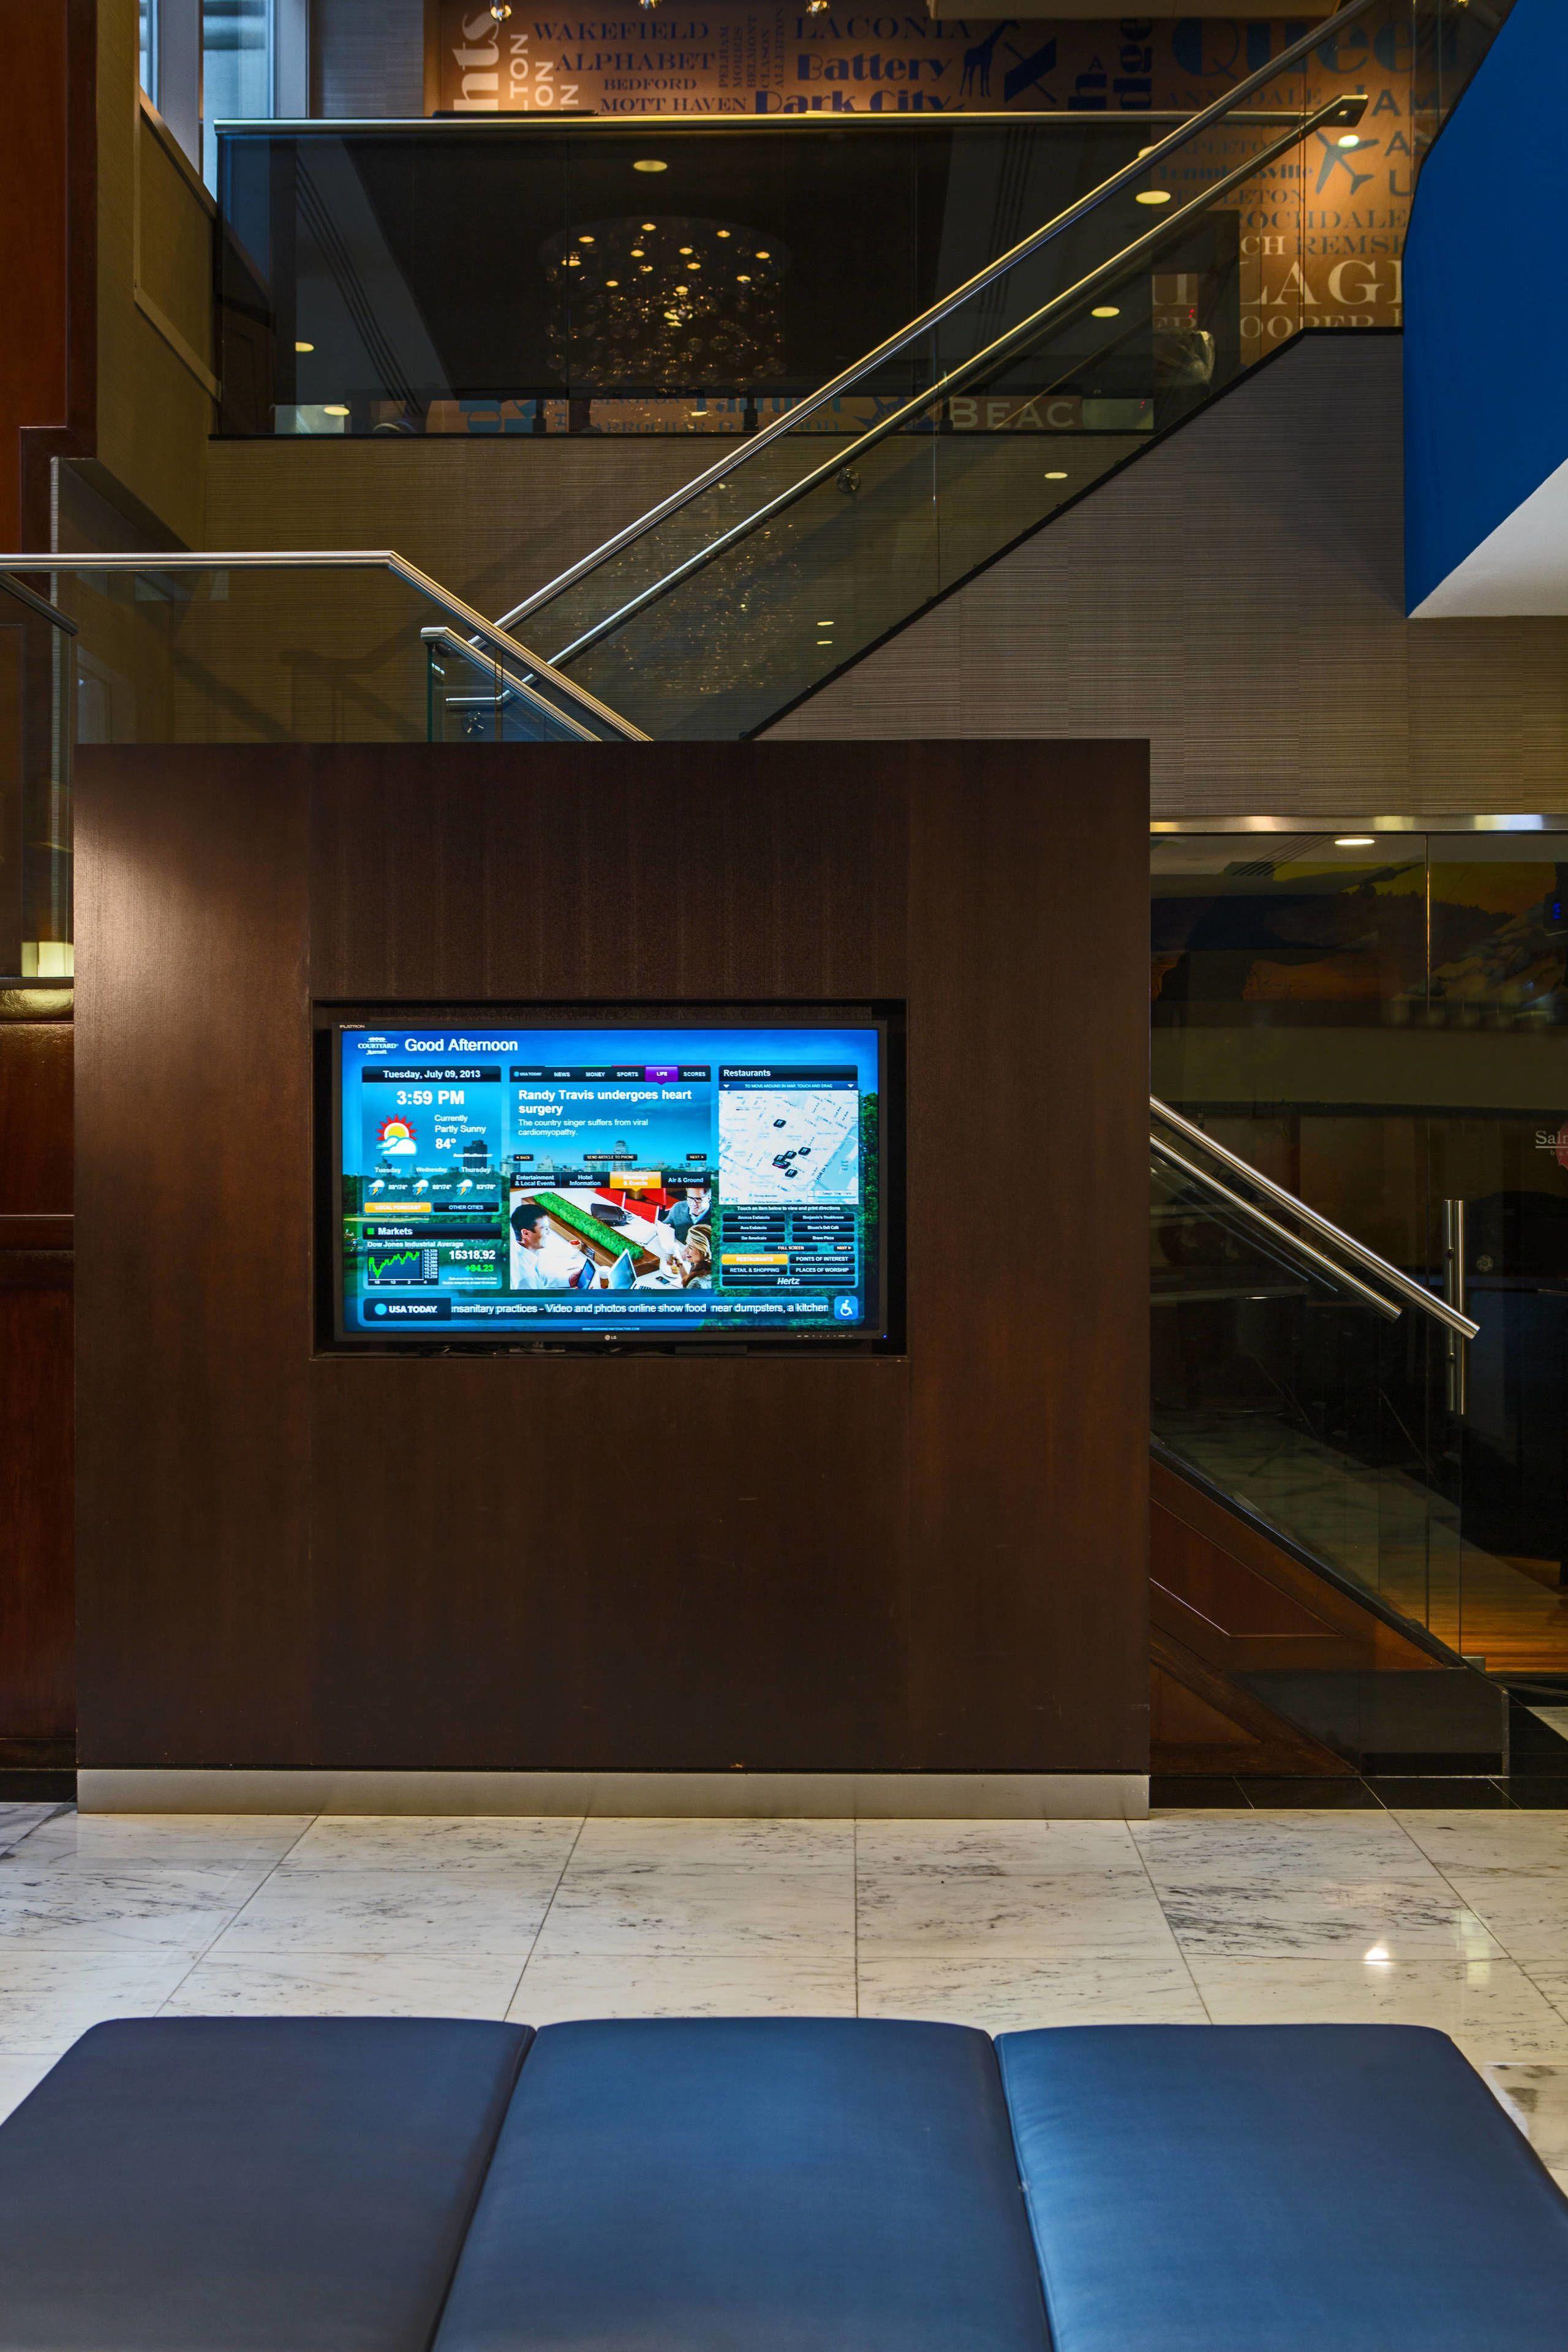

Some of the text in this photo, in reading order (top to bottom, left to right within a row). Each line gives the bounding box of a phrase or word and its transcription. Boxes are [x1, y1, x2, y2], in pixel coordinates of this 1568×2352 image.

[533, 21, 709, 40] WAKEFIELD
[794, 16, 974, 39] LACONIA
[747, 14, 757, 88] BELMONT
[557, 51, 715, 71] ALPHABET
[797, 53, 952, 81] Battery
[604, 78, 697, 91] BEDFORD
[600, 97, 747, 112] MOTT HAVEN
[755, 89, 951, 113] Park City
[404, 1038, 518, 1052] Good Afternoon
[383, 1070, 423, 1079] Tuesday,
[424, 1070, 443, 1079] July
[445, 1070, 458, 1079] 09,
[396, 1090, 465, 1105] 3:59 PM
[519, 1090, 692, 1102] Randy Travis undergoes heart
[518, 1105, 563, 1115] surgery
[434, 1114, 468, 1123] Currently
[564, 1119, 586, 1128] singer
[434, 1125, 486, 1134] Partly Sunny
[518, 1129, 579, 1137] cardiomyopathy.
[435, 1137, 456, 1149] 84°
[449, 1250, 496, 1260] 15318.92
[495, 1303, 538, 1315] practices
[545, 1303, 573, 1313] Video
[573, 1304, 593, 1313] and
[594, 1304, 627, 1314] photos
[628, 1304, 657, 1313] online
[657, 1304, 684, 1313] show
[684, 1303, 706, 1313] food
[733, 1303, 786, 1314] dumpsters,
[795, 1303, 829, 1312] kitchen
